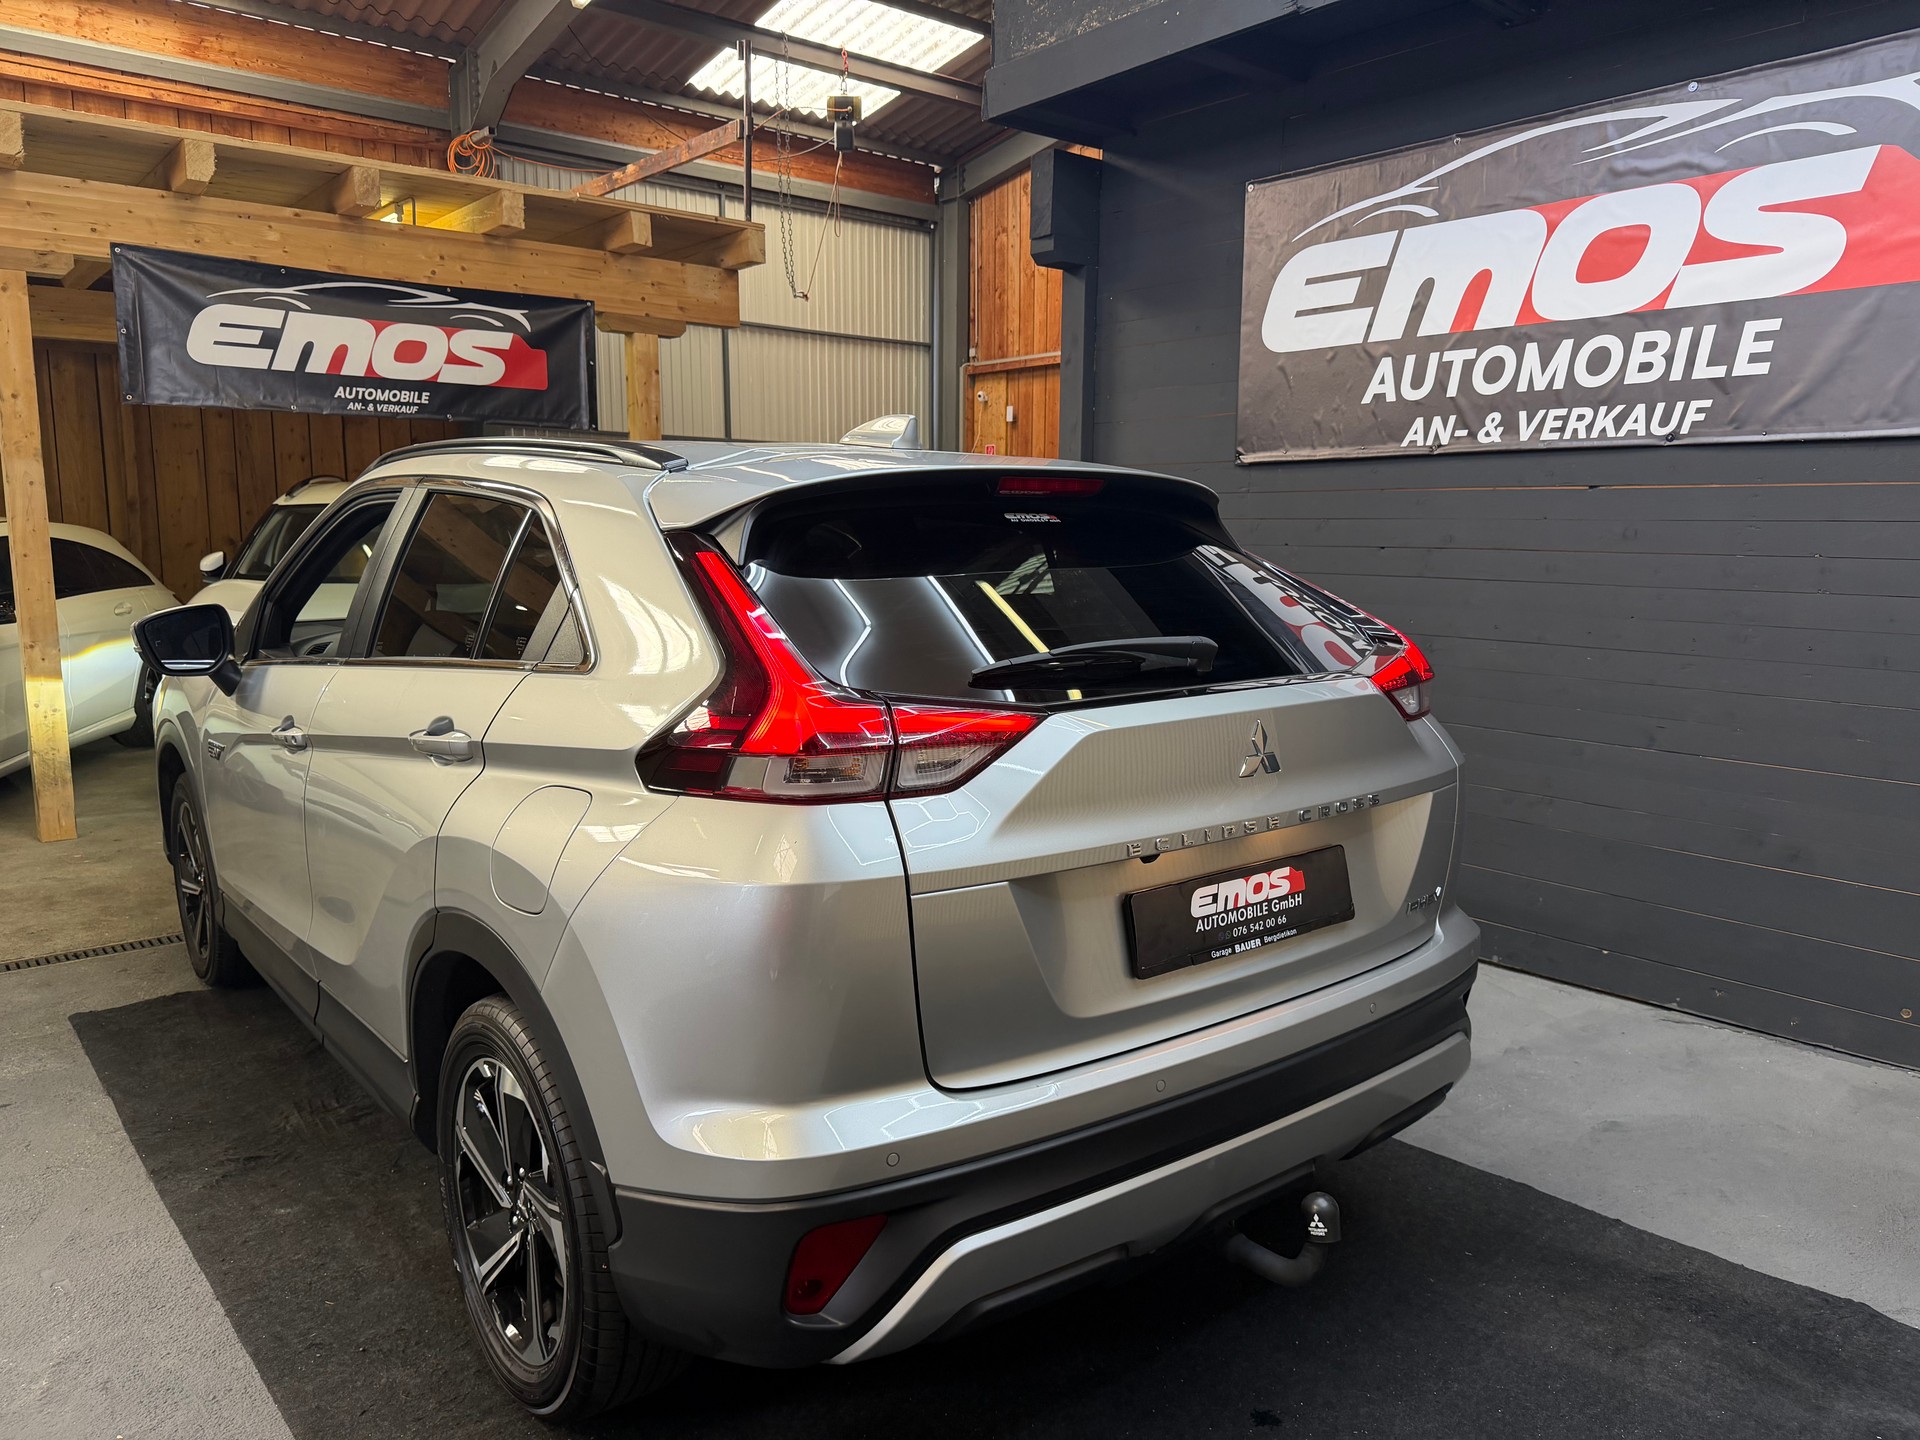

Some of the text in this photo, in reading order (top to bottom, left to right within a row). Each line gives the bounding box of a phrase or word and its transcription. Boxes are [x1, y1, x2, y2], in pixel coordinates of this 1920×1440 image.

[1261, 144, 1882, 354] EMOS
[186, 304, 514, 386] EMOS
[1361, 317, 1783, 405] AUTOMOBILE
[334, 386, 430, 404] AUTOMOBILE
[347, 402, 419, 414] AN- & VERKAUF
[1401, 399, 1714, 447] AN- & VERKAUF
[1127, 794, 1380, 857] ECLIPSE CROSS
[1190, 866, 1291, 919] EMOS
[1195, 893, 1303, 933] AUTOMOBILE GmbH
[1210, 928, 1298, 959] Garage BAUER Bergdietikon
[1232, 914, 1287, 938] 076 542 00 66
